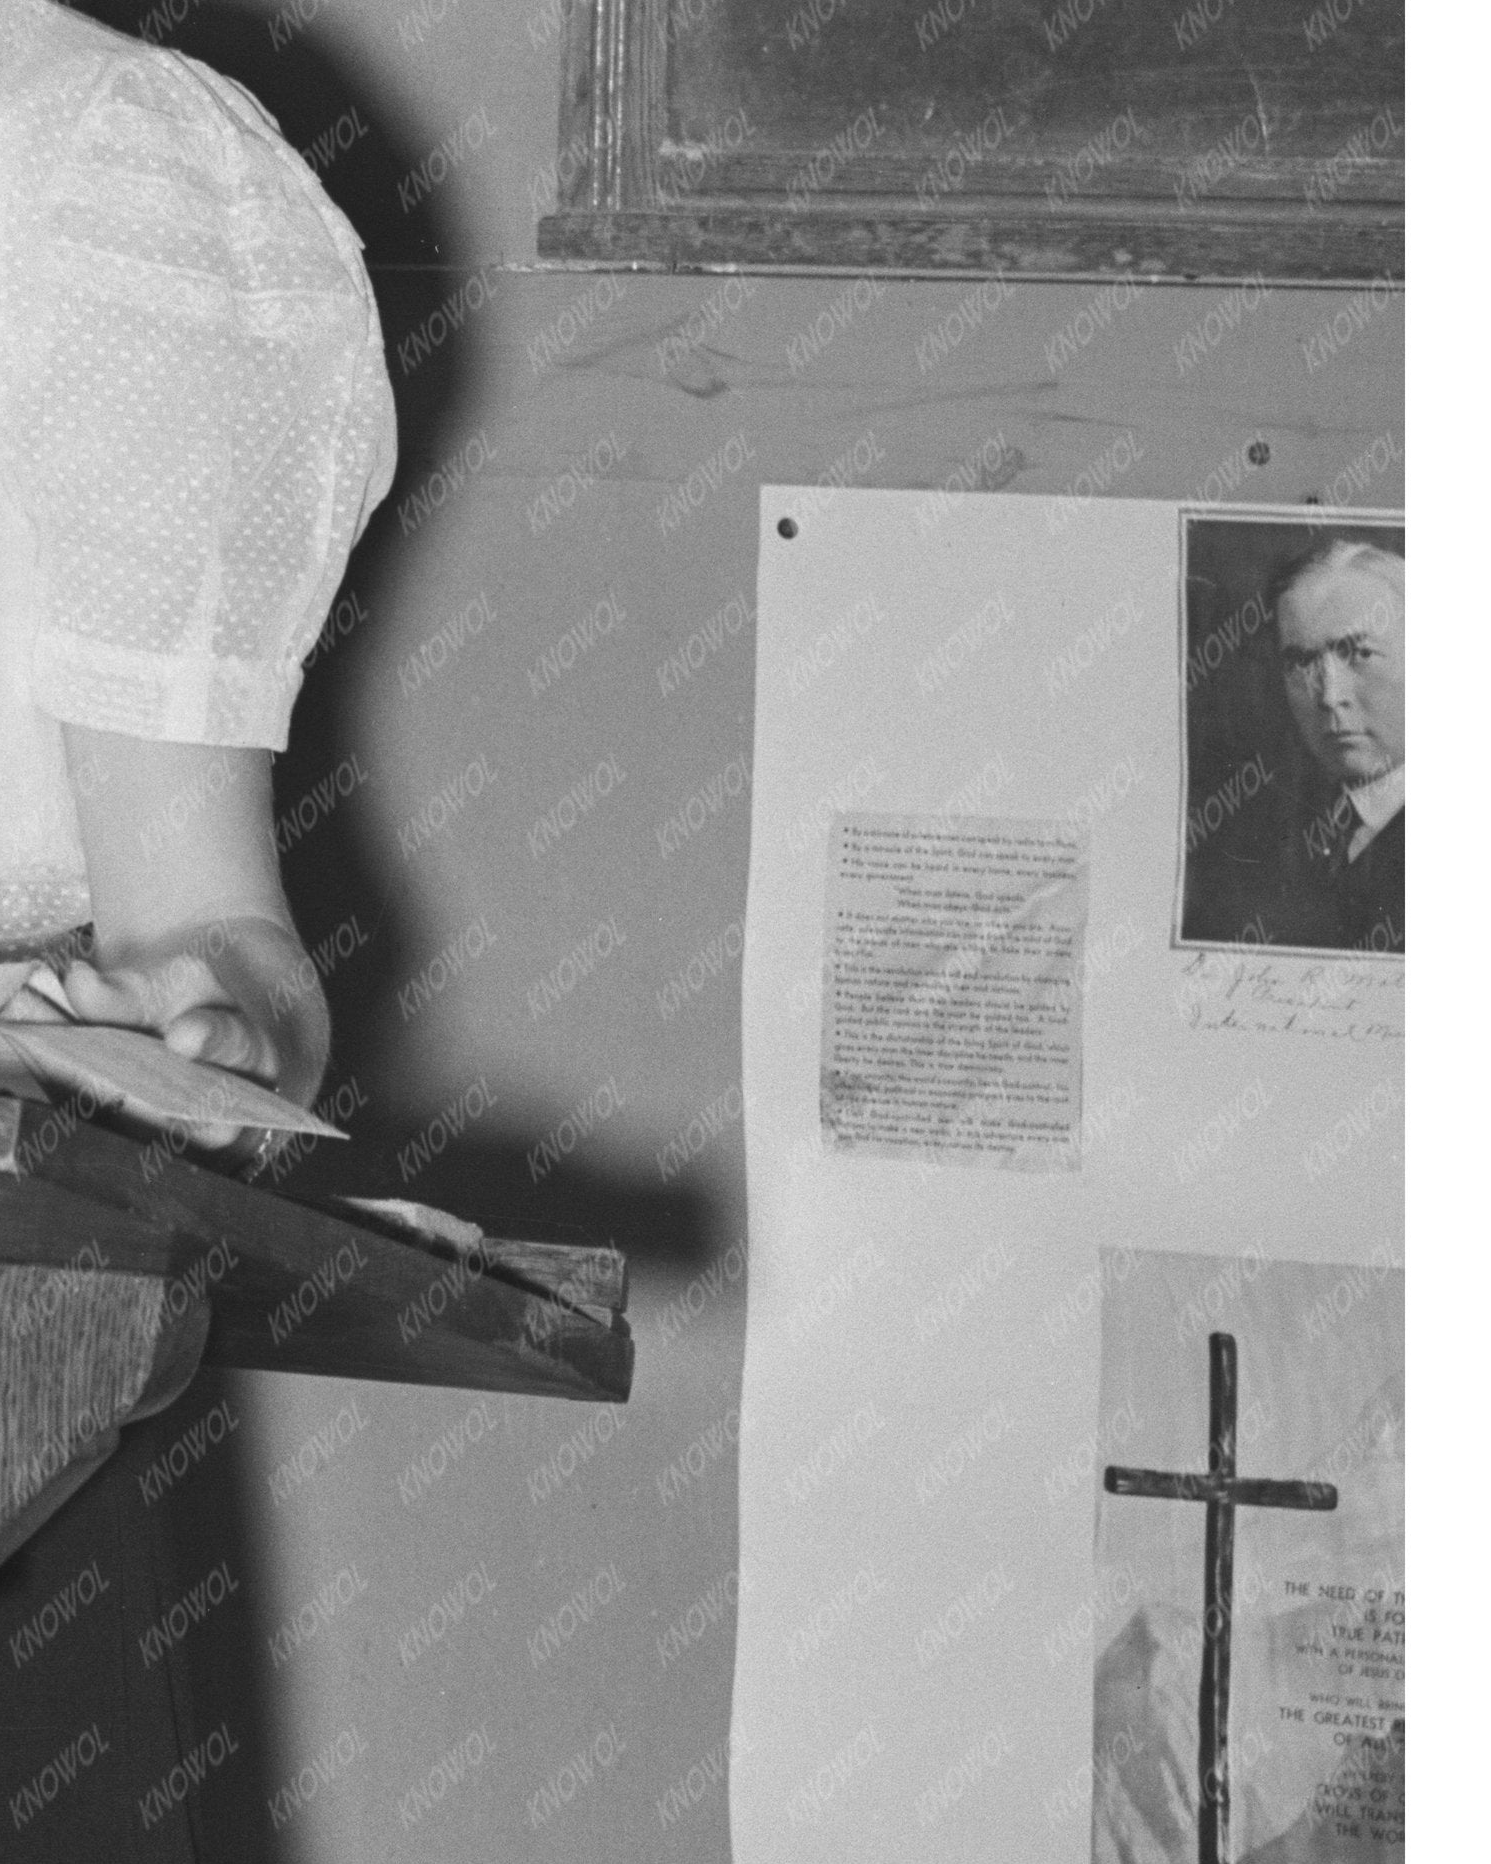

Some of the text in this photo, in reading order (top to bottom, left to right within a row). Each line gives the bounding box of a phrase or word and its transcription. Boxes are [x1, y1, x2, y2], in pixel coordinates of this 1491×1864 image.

[1284, 1581, 1308, 1596] THE
[1318, 1584, 1355, 1600] NEED
[1363, 1587, 1384, 1603] OF
[1331, 1624, 1364, 1641] TRUE
[1278, 1706, 1305, 1721] THE
[1313, 1710, 1385, 1729] GREATEST
[1332, 1730, 1353, 1746] OF
[1368, 1787, 1388, 1803] OF
[1313, 1798, 1352, 1818] WILL
[1334, 1822, 1360, 1837] THE
